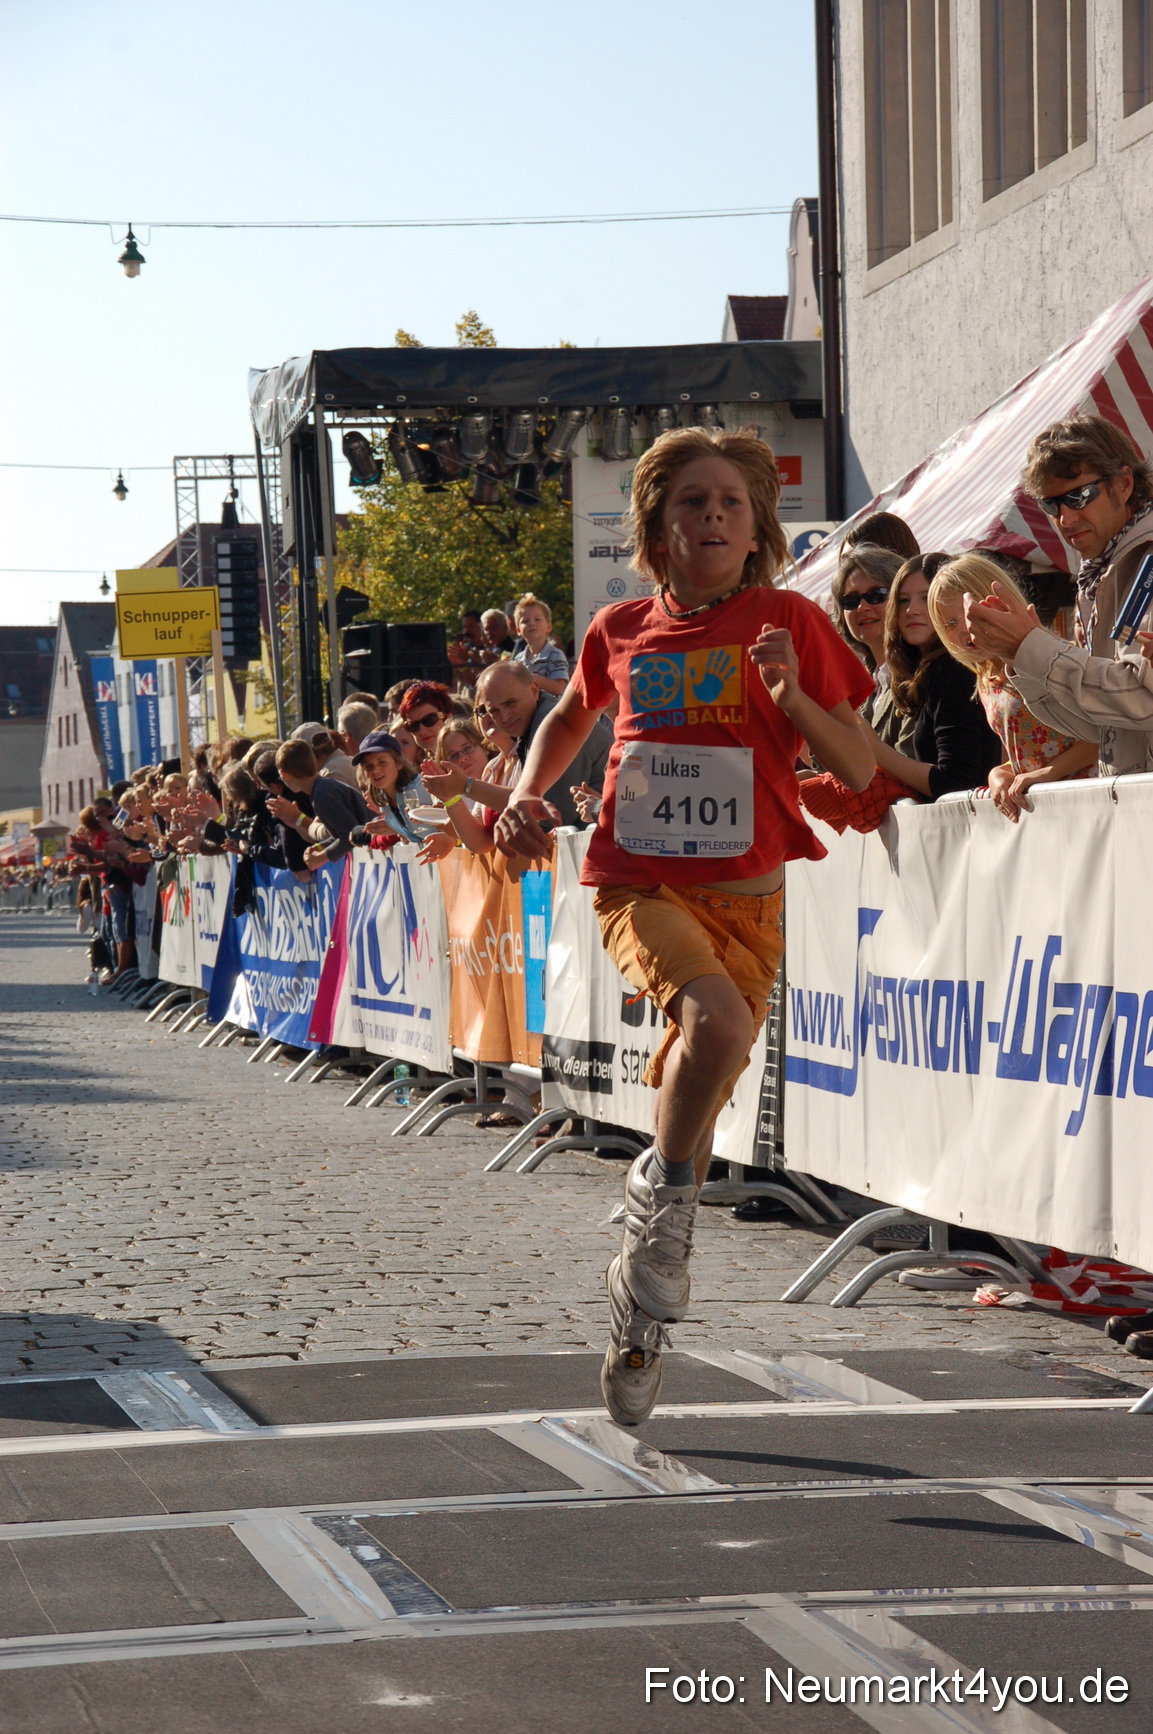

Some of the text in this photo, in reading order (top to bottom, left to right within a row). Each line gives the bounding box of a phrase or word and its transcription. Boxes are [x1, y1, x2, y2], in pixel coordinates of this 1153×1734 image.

[123, 609, 210, 625] Schnupper-
[155, 627, 182, 641] lauf
[632, 707, 742, 731] HANDBALL
[651, 755, 700, 777] Lukas
[621, 785, 635, 801] Ju
[652, 795, 738, 826] 4101
[699, 841, 751, 850] PFLEIDERER
